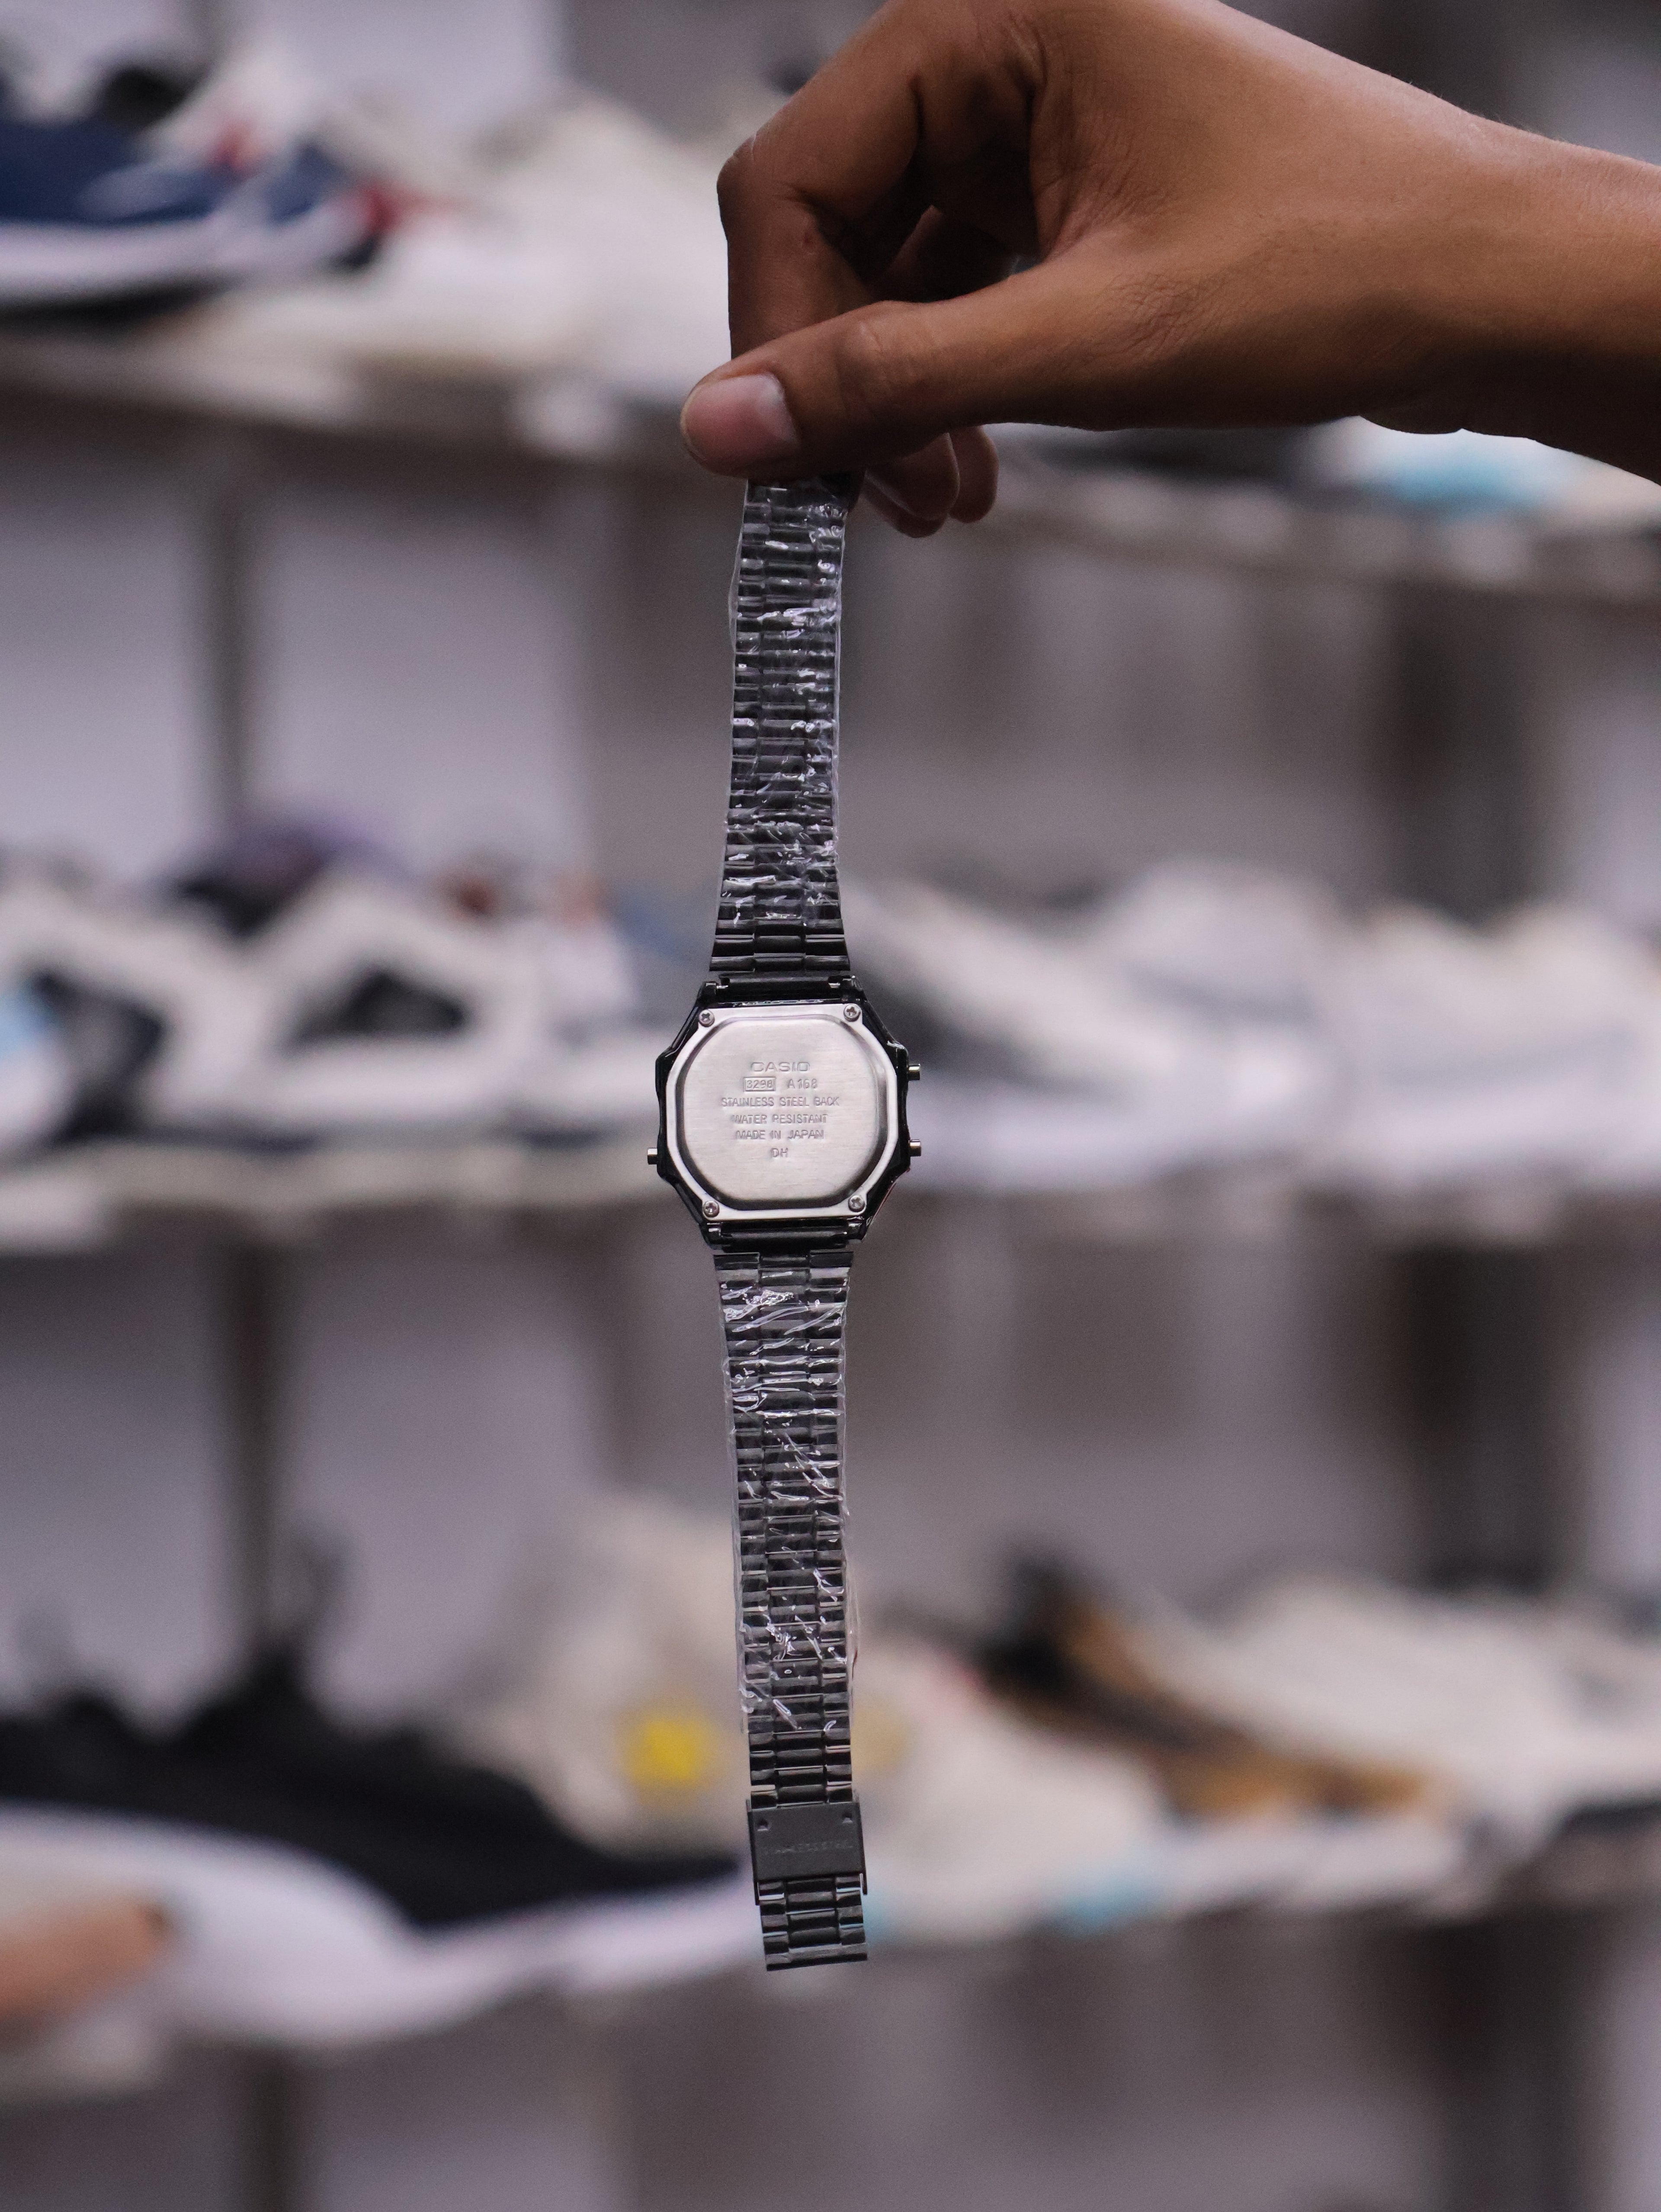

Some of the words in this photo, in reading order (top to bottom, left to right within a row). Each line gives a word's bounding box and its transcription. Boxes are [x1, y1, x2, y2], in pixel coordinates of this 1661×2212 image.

[751, 1062, 810, 1072] CASIO
[746, 1079, 773, 1088] 3298
[787, 1079, 818, 1089] A168
[721, 1097, 774, 1106] STAINLESS
[779, 1097, 809, 1106] STEEL
[814, 1096, 840, 1106] BACK
[732, 1114, 767, 1124] WATER
[773, 1114, 828, 1124] RESISTANT
[736, 1130, 766, 1140] MADE
[770, 1130, 781, 1139] IN
[788, 1130, 824, 1140] JAPAN
[771, 1148, 789, 1158] DH
